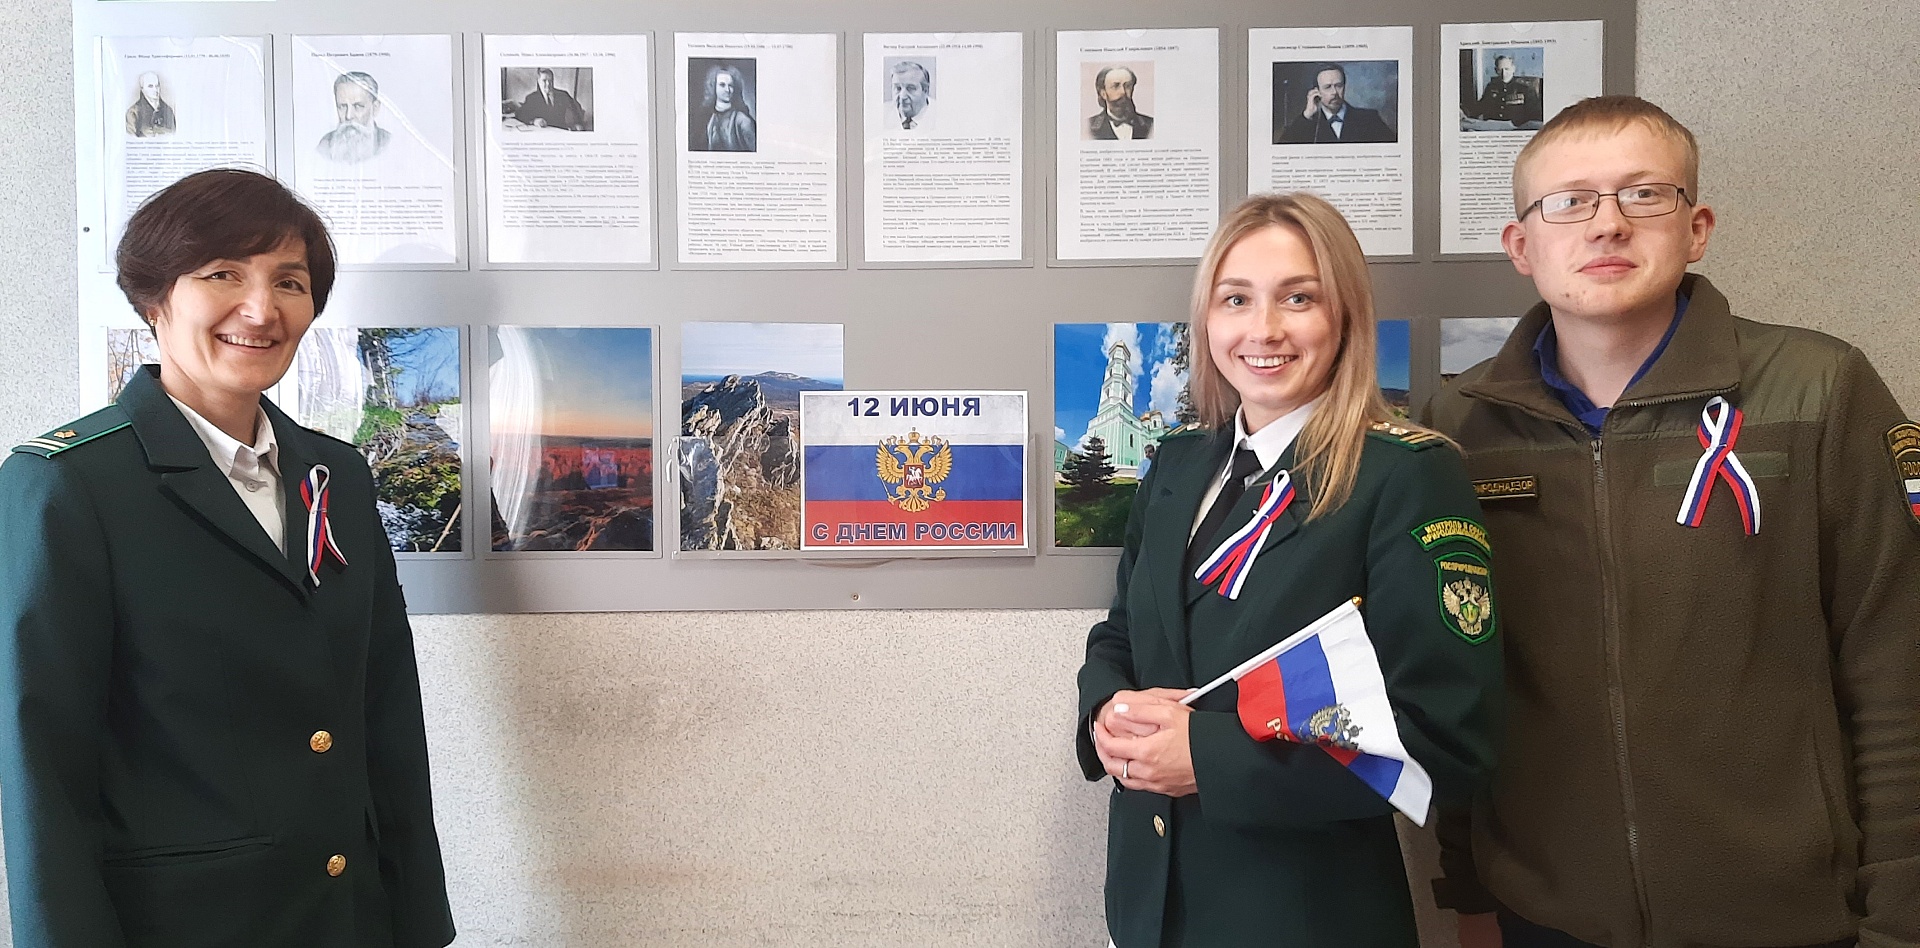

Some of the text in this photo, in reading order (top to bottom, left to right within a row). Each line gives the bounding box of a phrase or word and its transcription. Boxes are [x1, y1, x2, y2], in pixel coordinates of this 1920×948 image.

[847, 397, 981, 417] 12 ИЮНЯ
[812, 522, 1016, 543] С ДНЕМ РОССИИ
